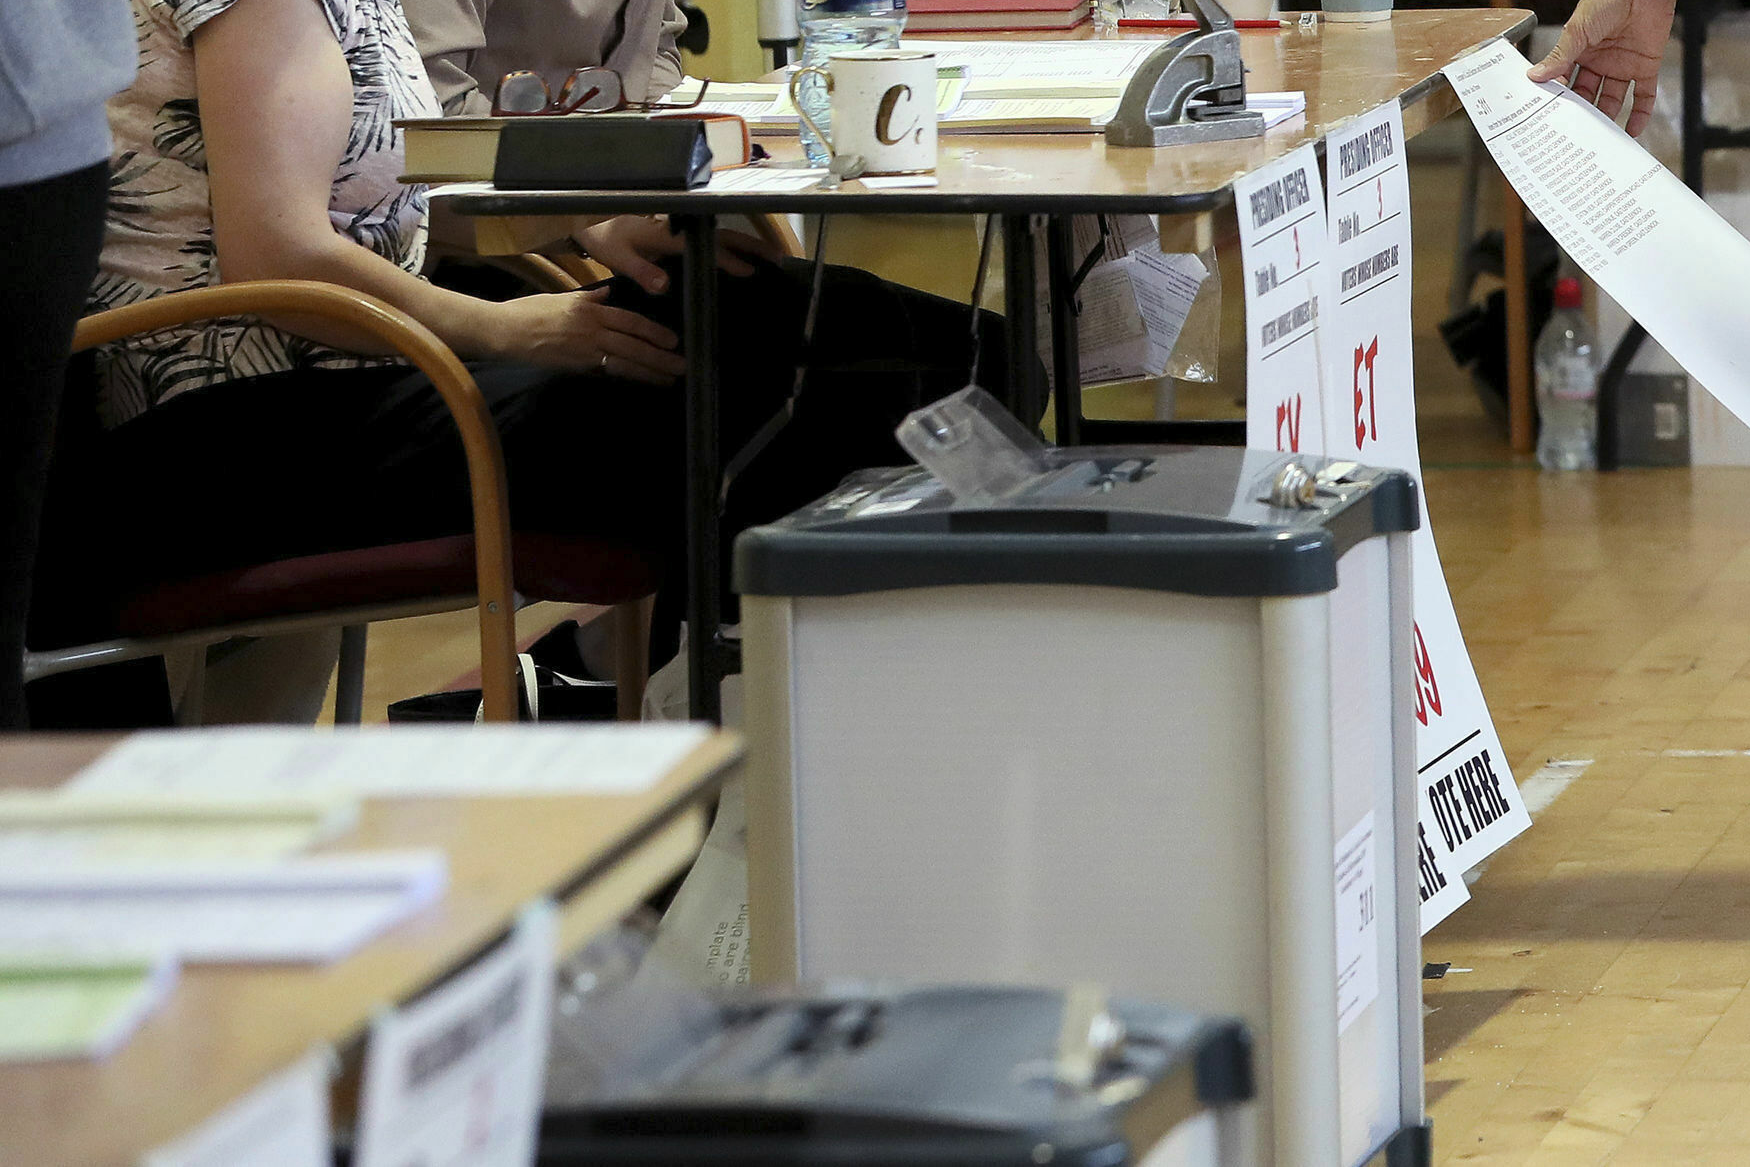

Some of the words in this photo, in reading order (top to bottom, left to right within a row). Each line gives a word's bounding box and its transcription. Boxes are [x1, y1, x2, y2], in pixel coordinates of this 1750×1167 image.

[1339, 131, 1371, 180] PRESIDING
[1369, 120, 1394, 165] OFFICER
[1249, 180, 1285, 231] PRESIDING
[1282, 166, 1311, 213] OFFICER
[1338, 214, 1352, 245] Table
[1254, 265, 1270, 297] Table
[1353, 334, 1379, 452] ET
[1426, 772, 1472, 854] OTE
[1453, 748, 1511, 833] HERE
[724, 942, 740, 968] are
